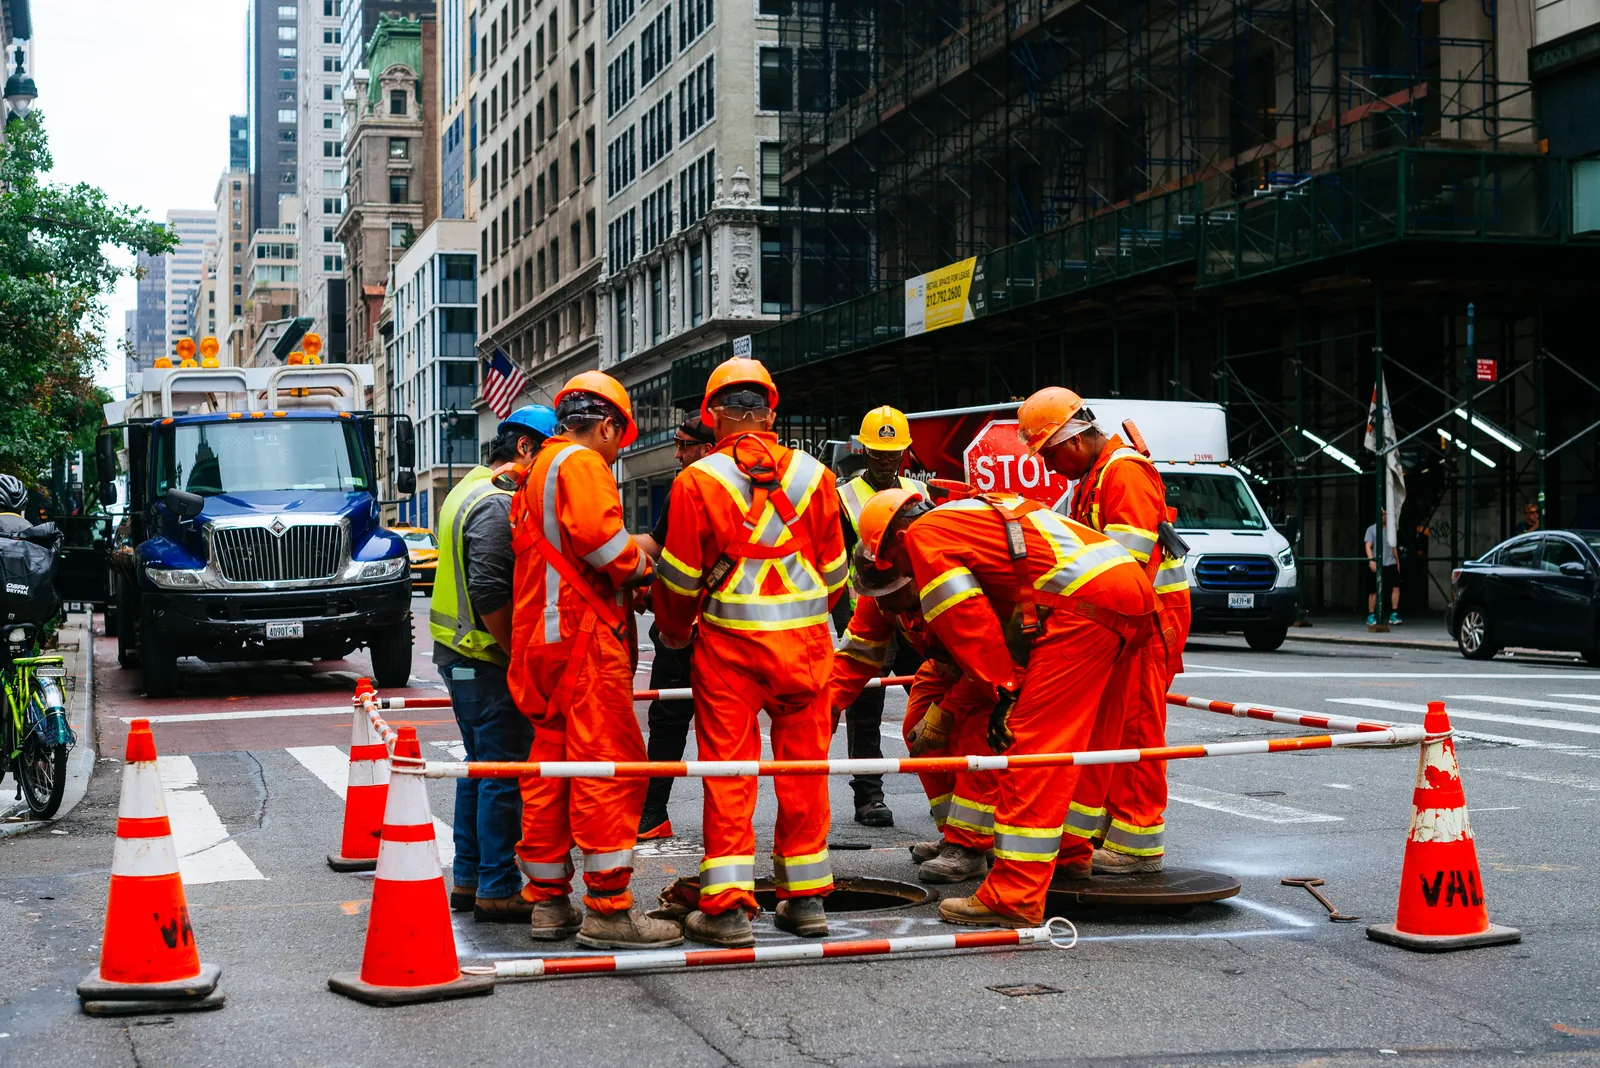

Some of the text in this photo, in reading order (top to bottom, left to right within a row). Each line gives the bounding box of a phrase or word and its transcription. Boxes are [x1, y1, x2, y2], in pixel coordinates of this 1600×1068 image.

[926, 280, 939, 291] RETAIL
[939, 276, 951, 288] SPACE
[950, 273, 958, 283] FOR
[958, 269, 971, 281] LEASE
[926, 285, 962, 308] 212.792.2600
[734, 337, 750, 355] GEIGER
